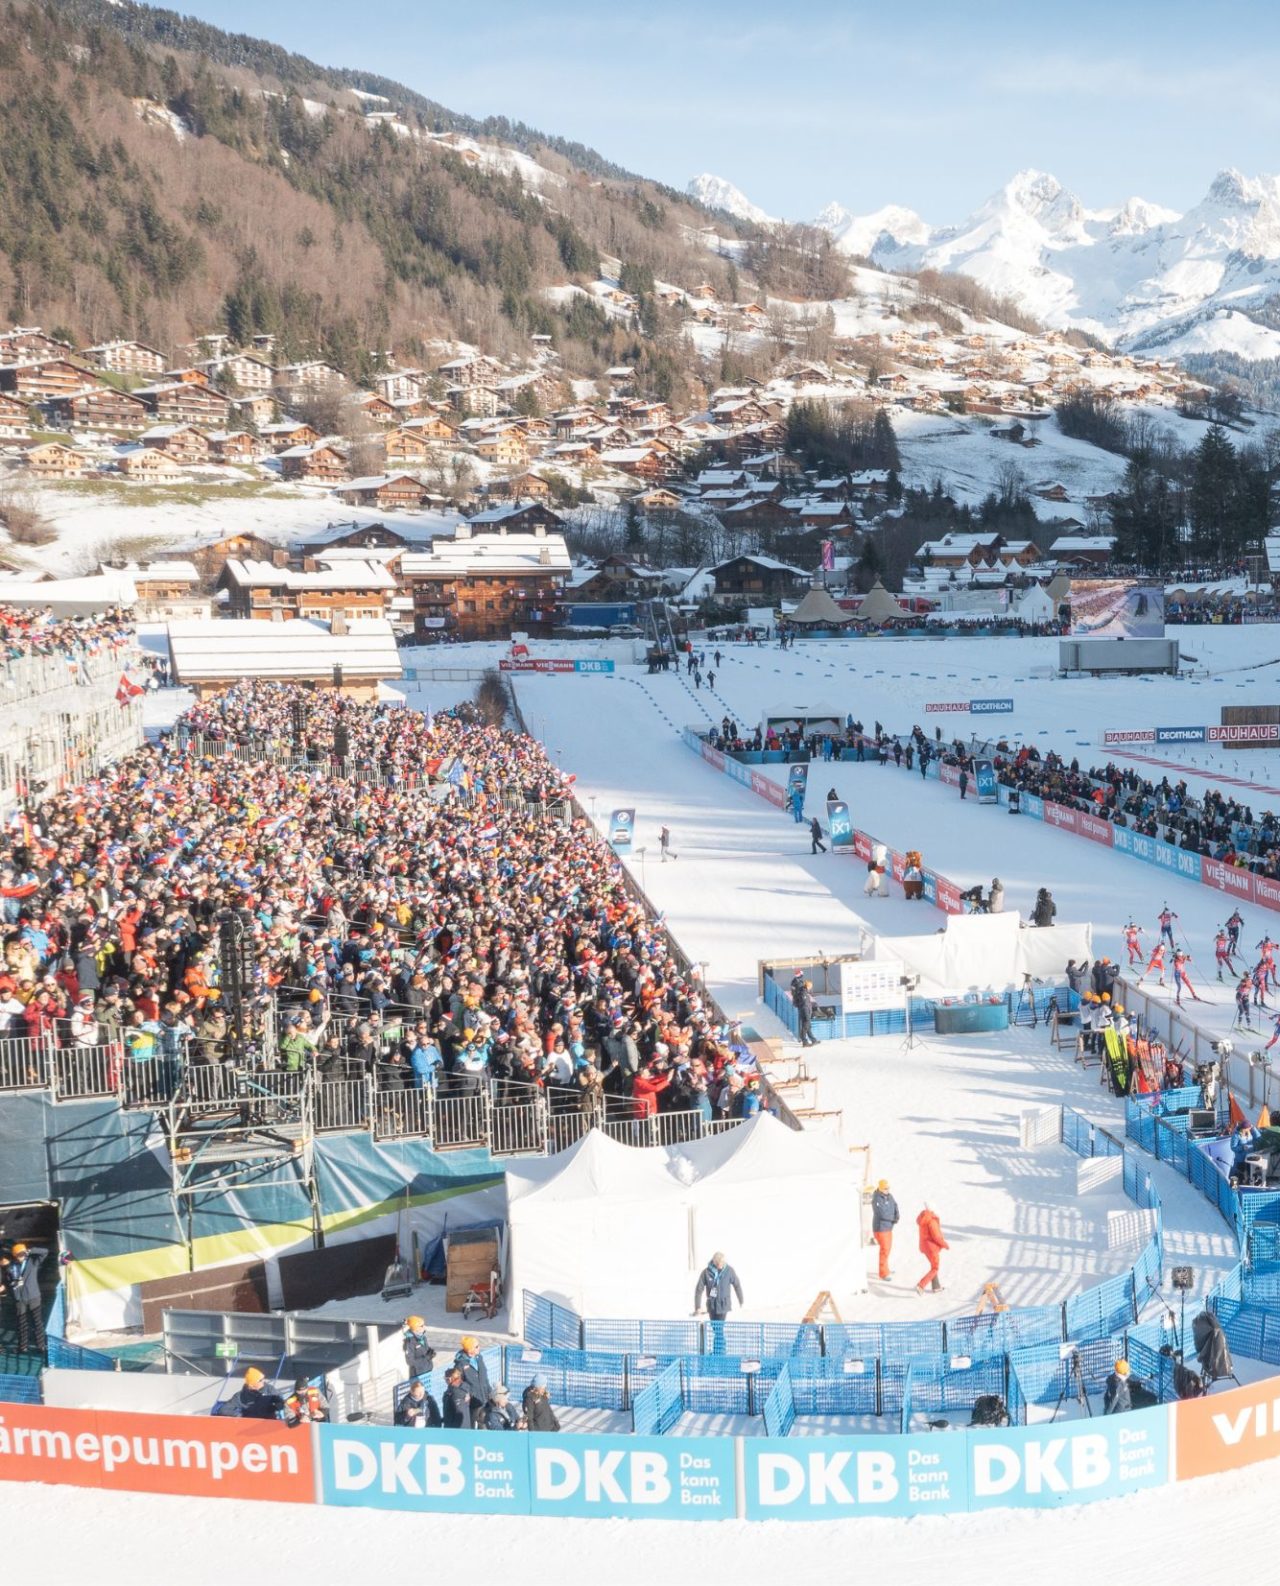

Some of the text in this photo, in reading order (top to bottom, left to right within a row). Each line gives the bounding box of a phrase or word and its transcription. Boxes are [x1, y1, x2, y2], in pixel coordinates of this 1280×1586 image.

[580, 661, 601, 671] DKB
[926, 703, 970, 712] BAUHAUS
[972, 702, 1012, 711] DECATHLON
[1106, 733, 1154, 742] BAUHAUS
[1159, 730, 1203, 740] DECATHLON
[1209, 725, 1278, 740] BAUHAUS
[1114, 829, 1128, 848] DKB
[1133, 837, 1148, 857] DKB
[1156, 845, 1171, 866] DKB
[1178, 853, 1194, 874] DKB
[1206, 863, 1249, 891] VIESSMANN
[1119, 1429, 1148, 1445] Das
[474, 1446, 504, 1463] Das
[681, 1453, 711, 1469] Das
[909, 1450, 940, 1466] Das
[1119, 1447, 1155, 1462] kann
[332, 1439, 466, 1497] DKB
[474, 1465, 513, 1480] kann
[973, 1433, 1111, 1497] DKB
[1119, 1463, 1155, 1481] Bank
[535, 1447, 672, 1504] DKB
[681, 1471, 720, 1487] kann
[757, 1451, 899, 1506] DKB
[909, 1468, 949, 1483] kann
[475, 1483, 515, 1499] Bank
[681, 1490, 721, 1505] Bank
[909, 1486, 950, 1502] Bank
